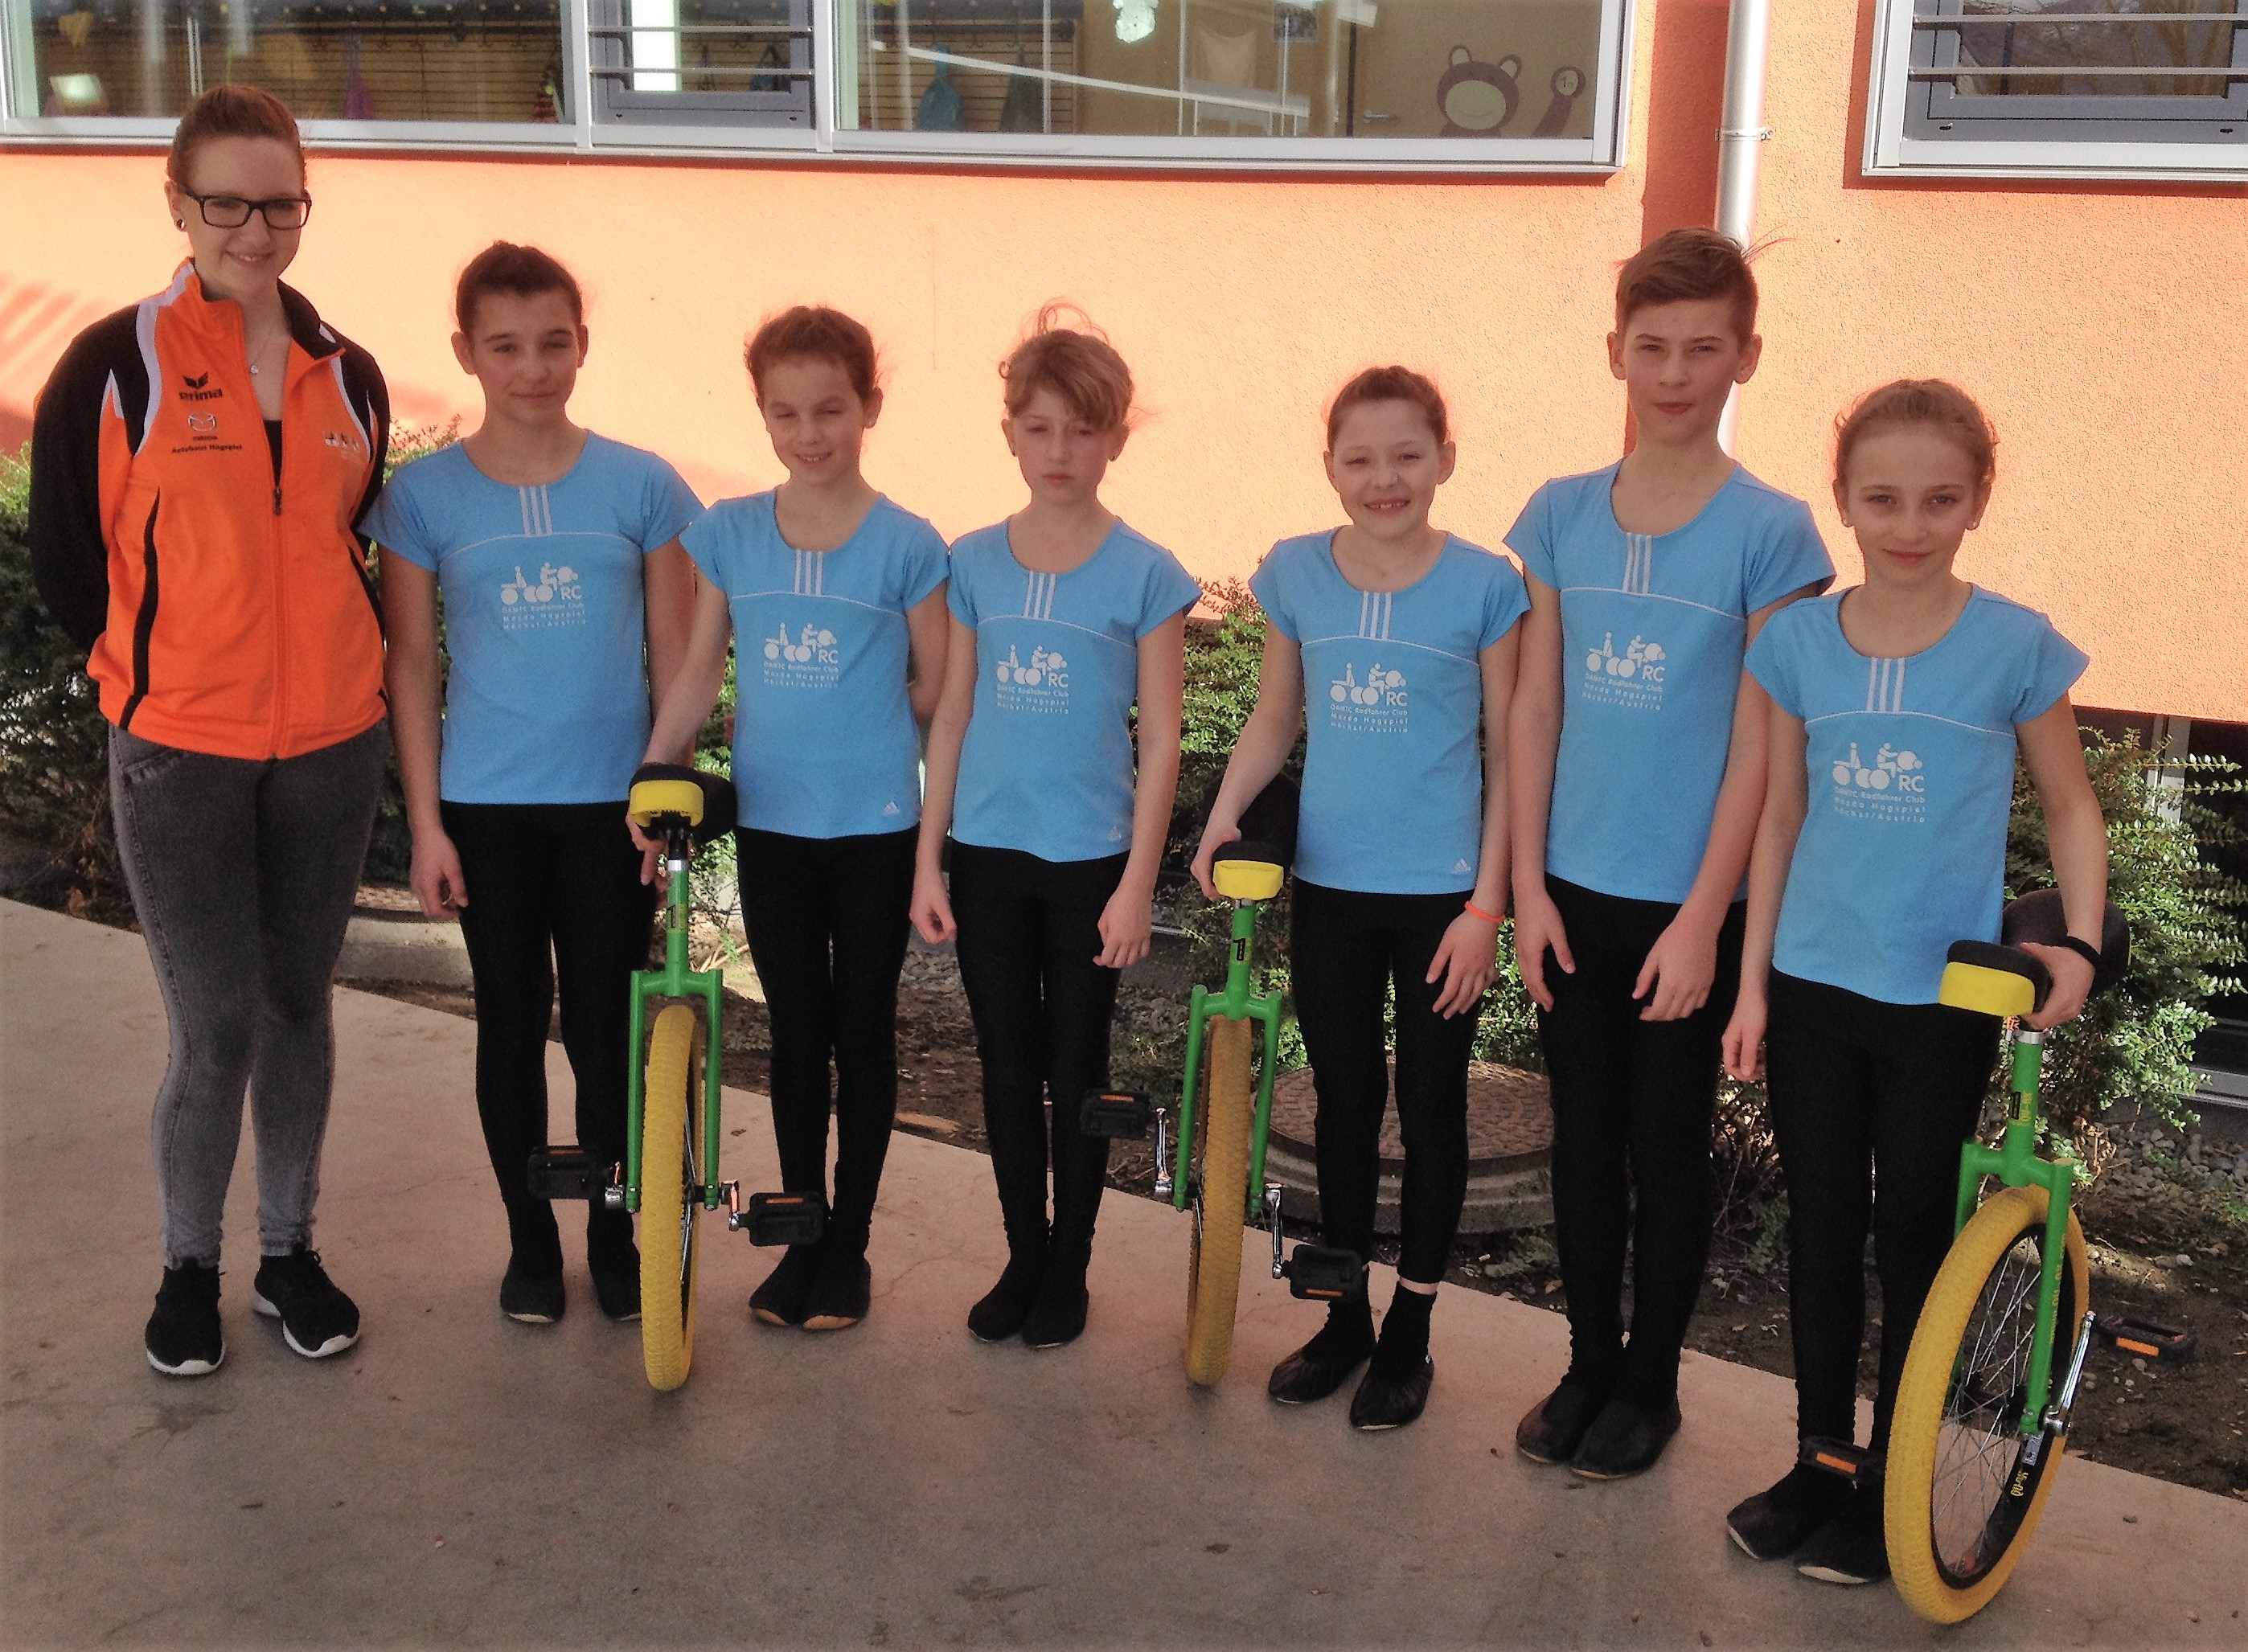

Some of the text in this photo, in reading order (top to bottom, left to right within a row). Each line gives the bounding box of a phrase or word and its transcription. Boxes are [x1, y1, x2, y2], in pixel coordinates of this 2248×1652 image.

[560, 585, 582, 601] RC
[818, 650, 839, 664] RC
[1048, 673, 1069, 688] RC
[1642, 665, 1665, 683] RC
[1386, 691, 1408, 707] RC
[1364, 717, 1408, 725] Hagspiel
[1898, 774, 1926, 793] RC
